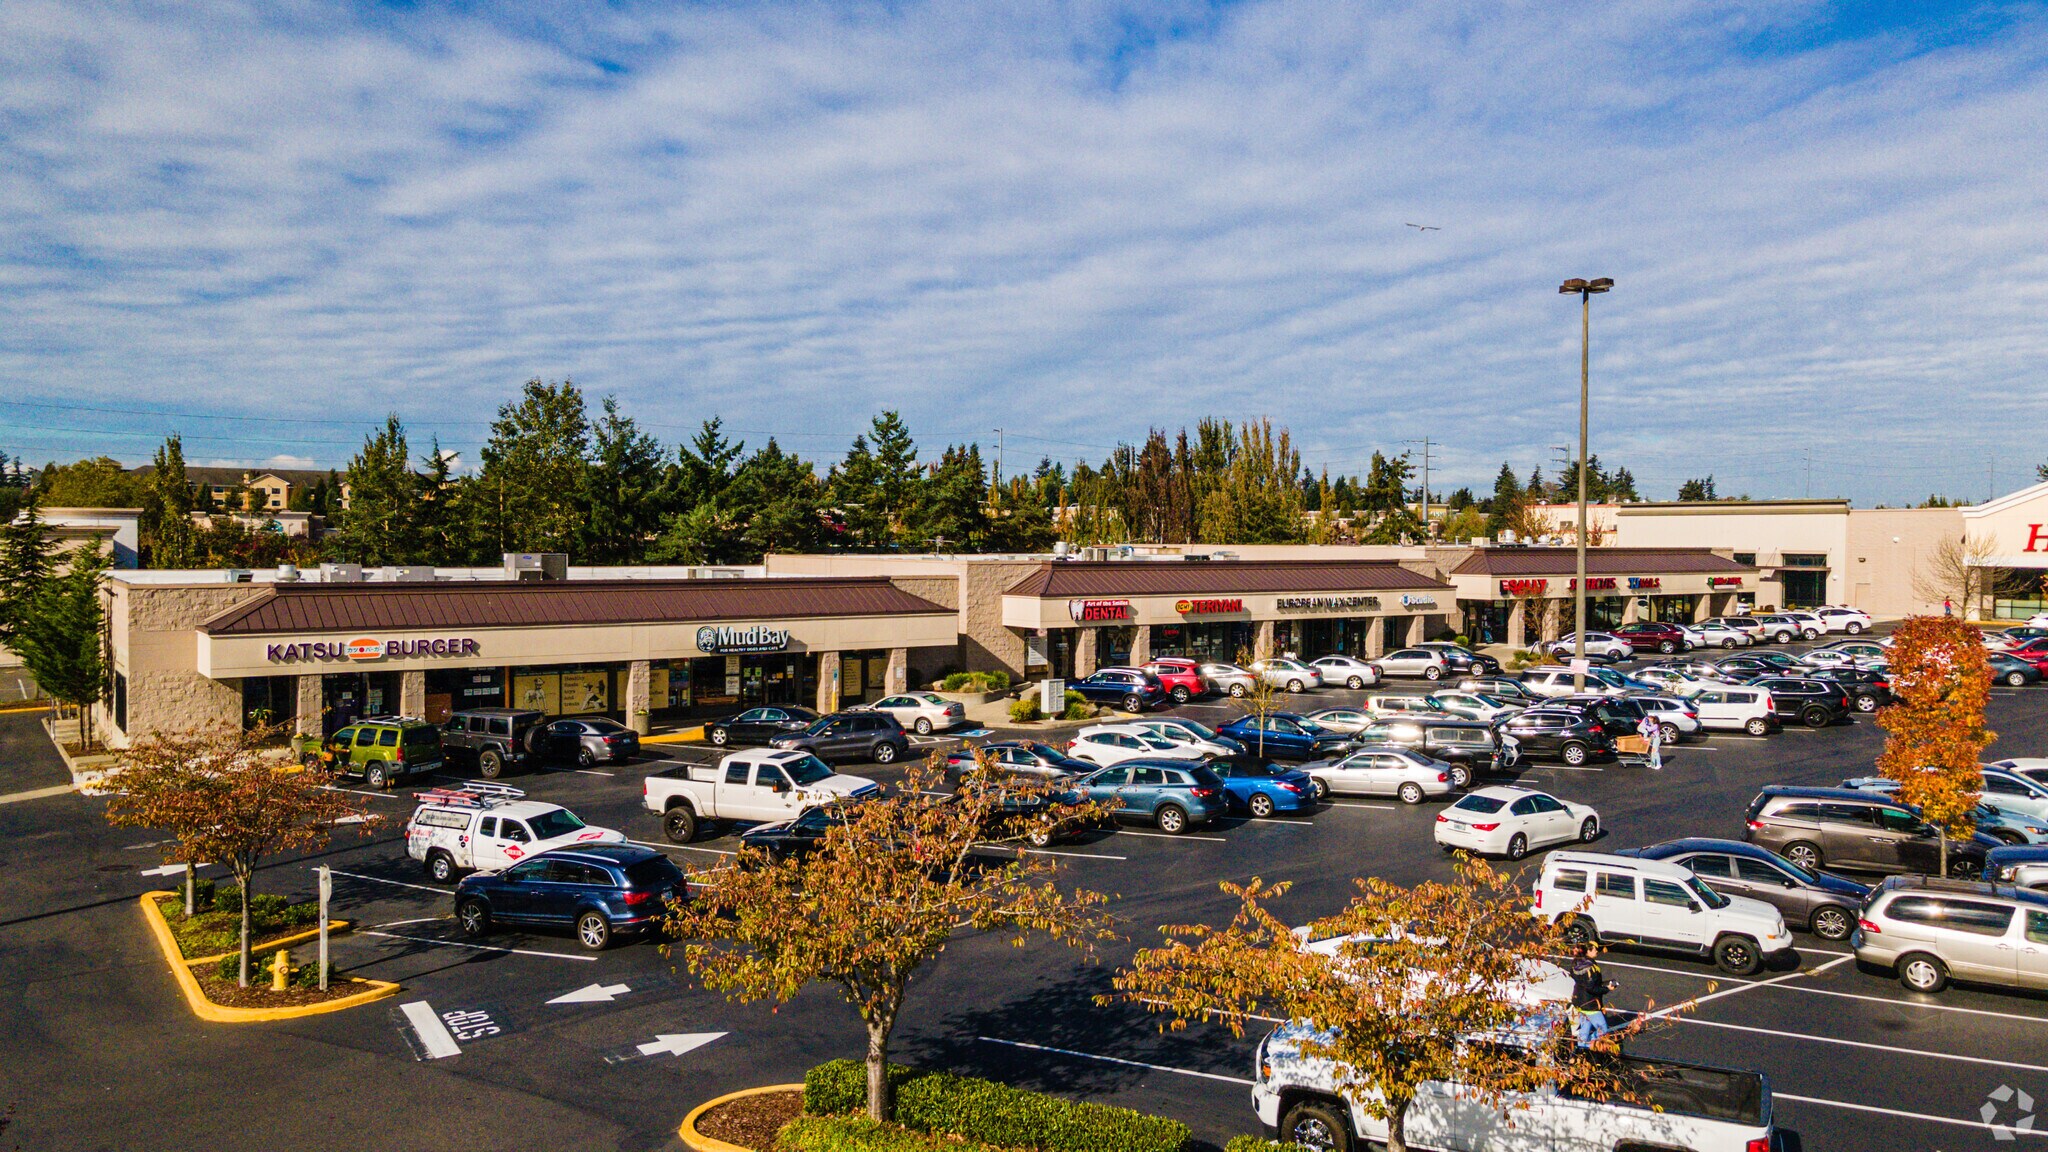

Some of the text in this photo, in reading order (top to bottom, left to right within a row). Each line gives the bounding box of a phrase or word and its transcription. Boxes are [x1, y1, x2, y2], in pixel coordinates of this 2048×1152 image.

[1569, 577, 1616, 590] SERCUTS
[1191, 599, 1243, 613] TERIYAKI
[1276, 596, 1378, 609] EUROPEAN WAX CENTER
[1085, 607, 1129, 620] DENTAL
[267, 638, 474, 660] KATSU BURGER
[442, 1010, 501, 1040] STOP
